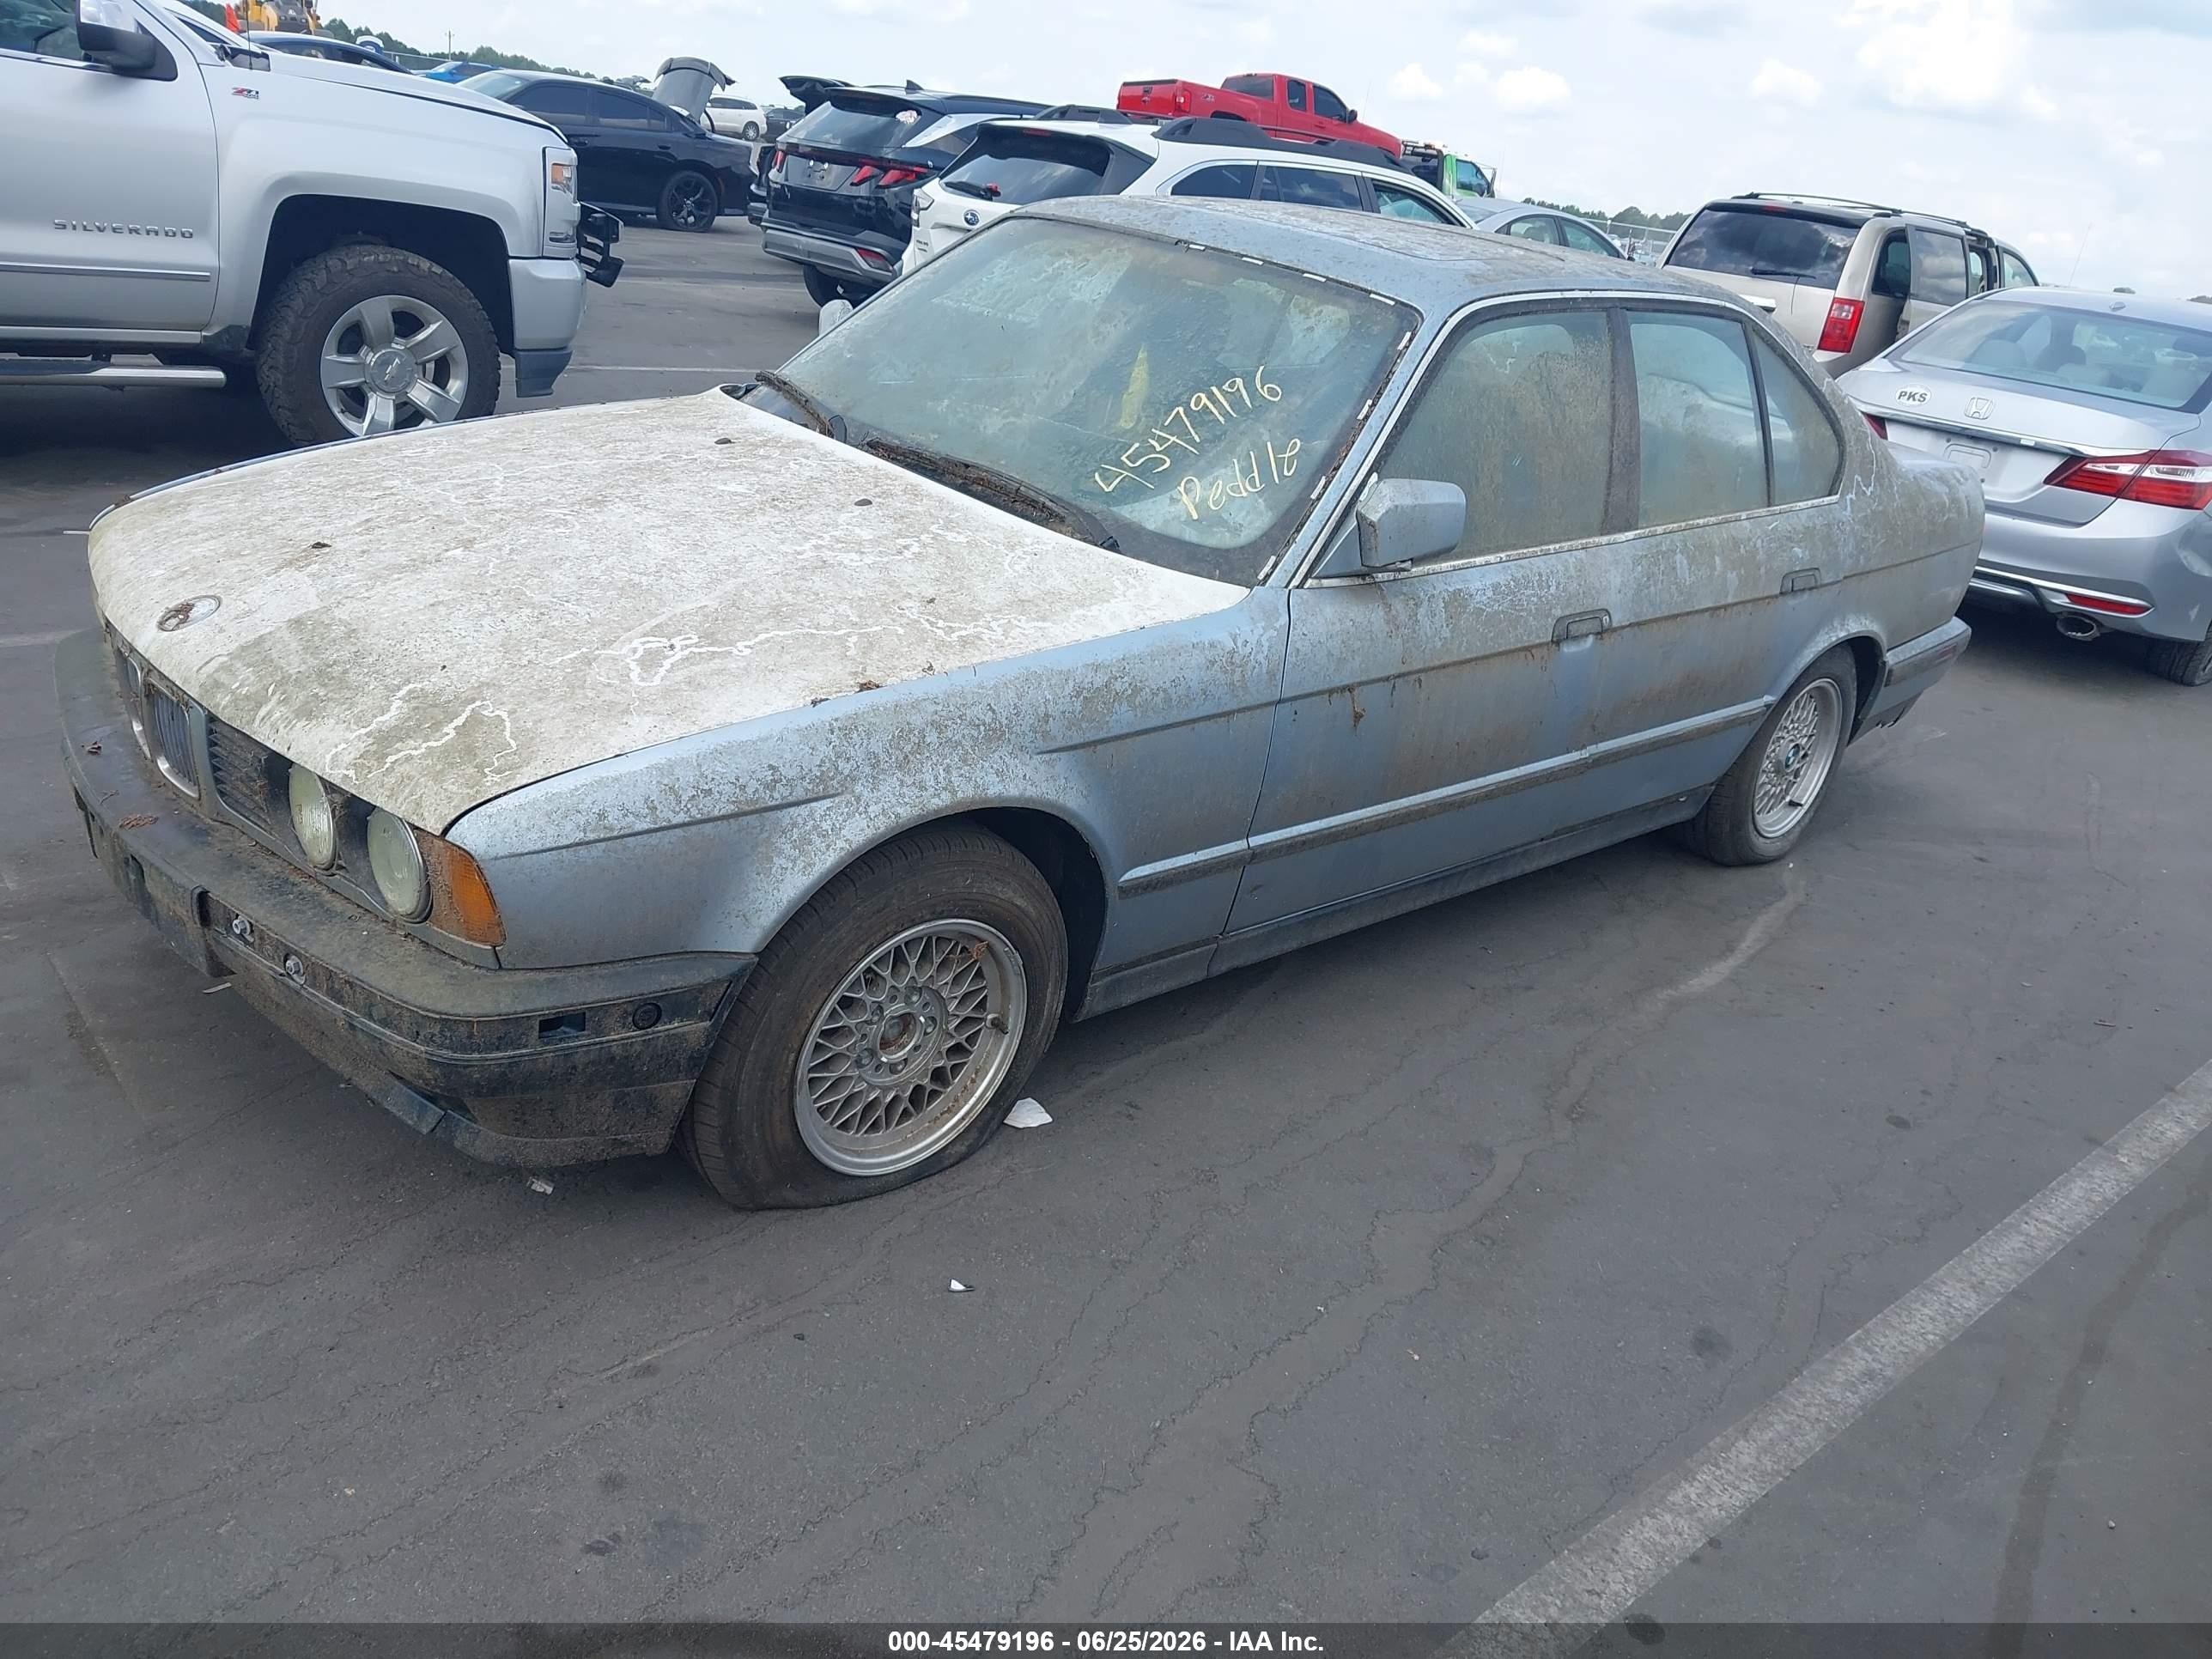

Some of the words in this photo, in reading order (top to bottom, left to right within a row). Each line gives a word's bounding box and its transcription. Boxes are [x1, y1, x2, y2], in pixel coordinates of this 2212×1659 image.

[53, 219, 194, 239] SILVERADO
[1897, 391, 1928, 403] PKS
[1094, 365, 1282, 493] 45479196
[1177, 438, 1301, 520] Peddle
